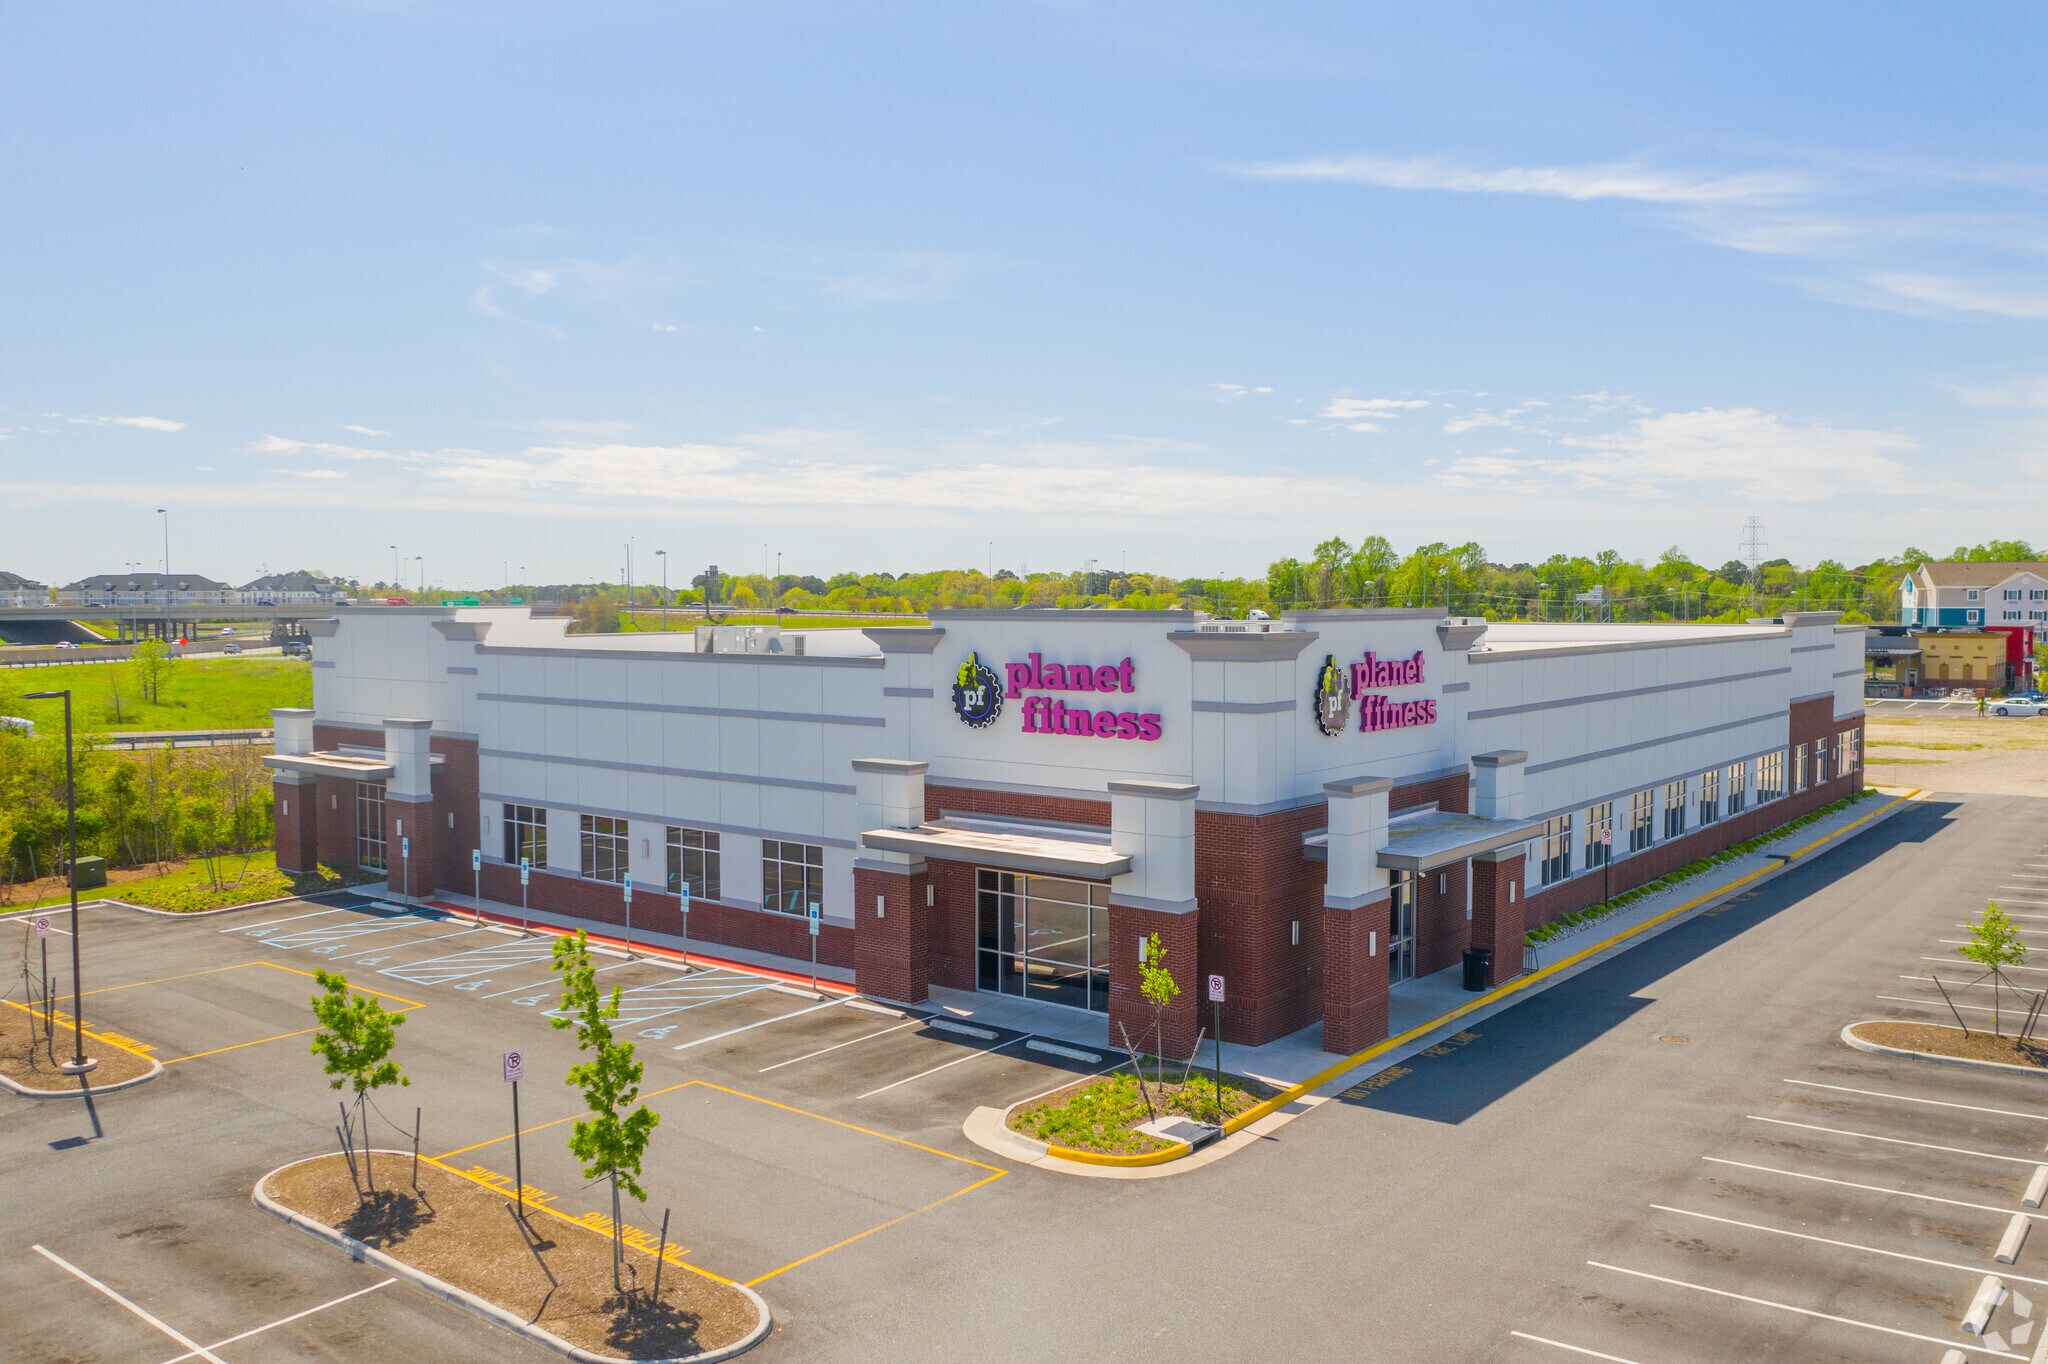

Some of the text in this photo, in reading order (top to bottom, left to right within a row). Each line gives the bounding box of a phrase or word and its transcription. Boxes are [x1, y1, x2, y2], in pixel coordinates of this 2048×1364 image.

[1005, 652, 1135, 699] planet
[1351, 651, 1424, 700] planet
[963, 686, 985, 711] pf
[1022, 696, 1162, 741] fitness
[1328, 688, 1343, 718] pf
[1360, 694, 1437, 732] fitness
